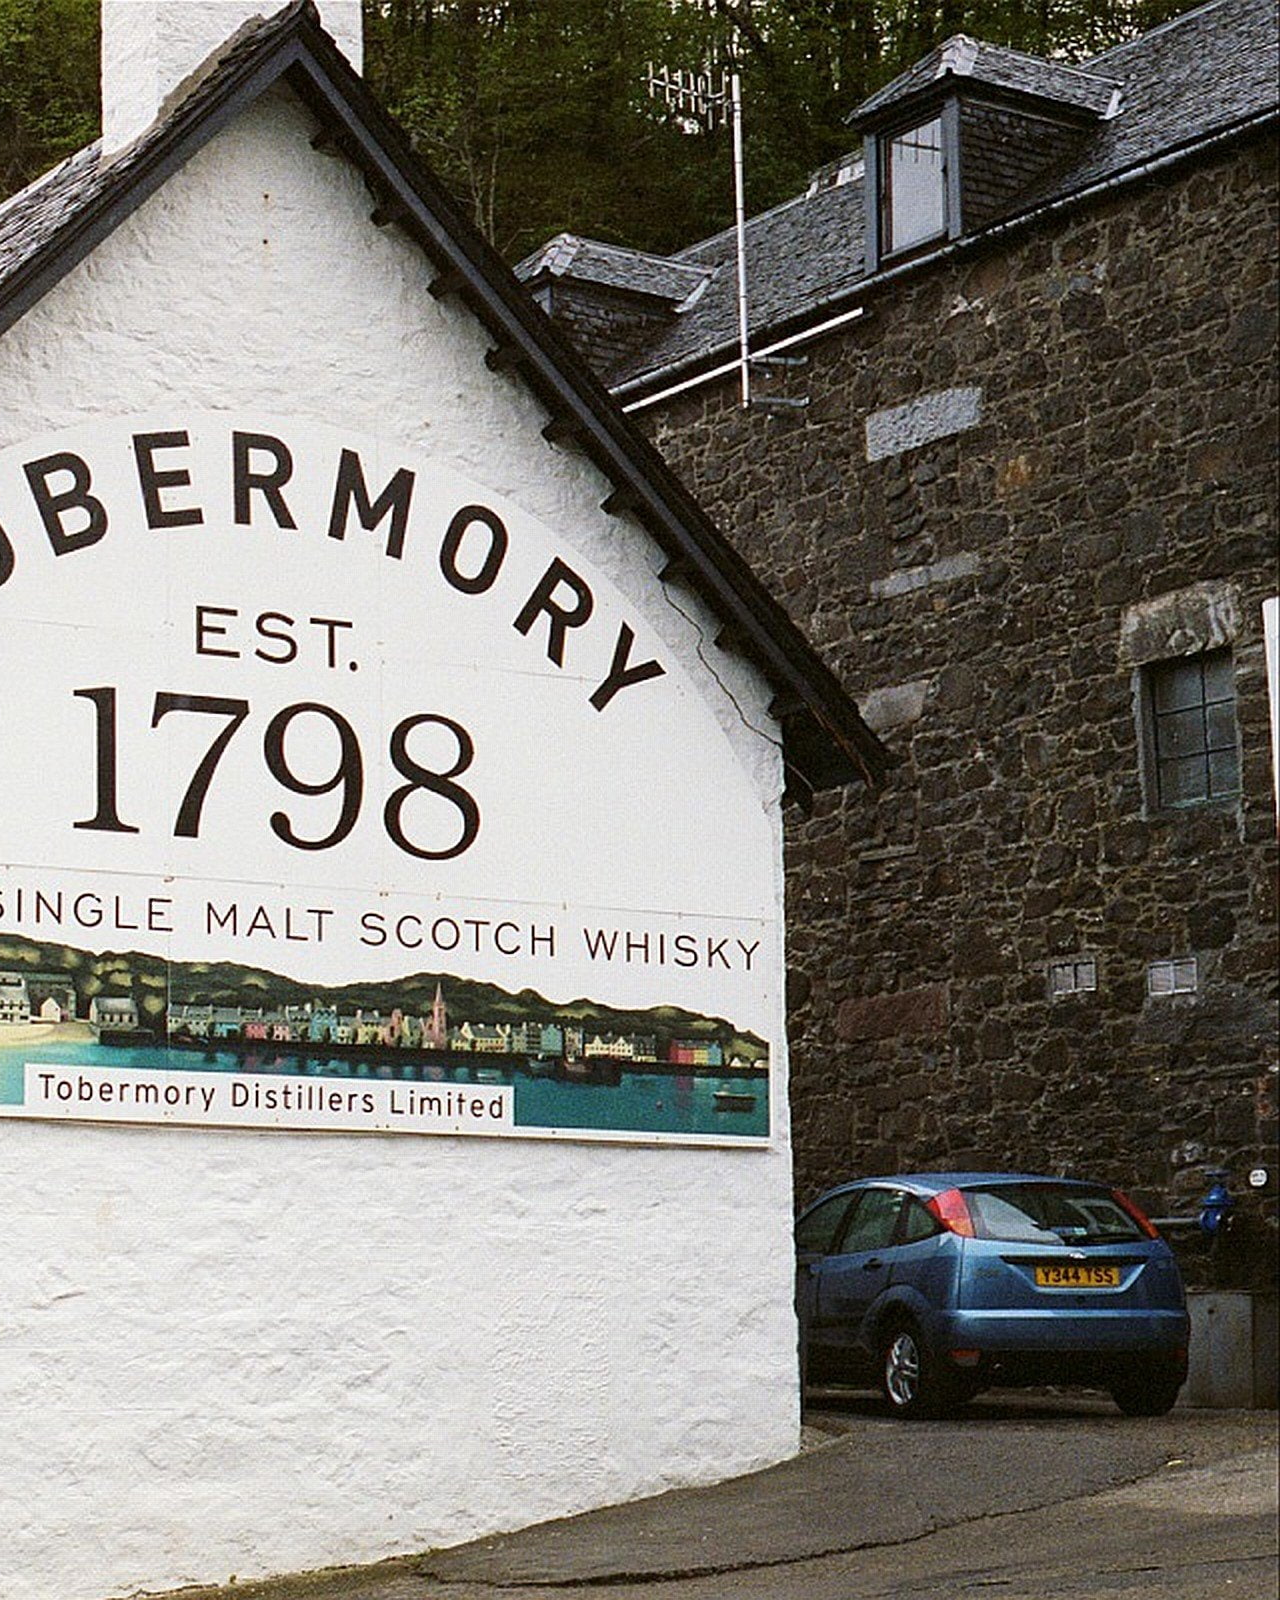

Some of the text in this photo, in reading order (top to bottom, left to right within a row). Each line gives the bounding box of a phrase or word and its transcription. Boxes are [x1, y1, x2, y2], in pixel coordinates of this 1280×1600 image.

[195, 605, 359, 672] EST.
[73, 686, 481, 861] 1798
[206, 901, 334, 942] MALT
[359, 912, 555, 957] SCOTCH
[583, 928, 761, 971] WHISKY
[38, 1073, 504, 1119] Tobermory Distillers Limited
[1042, 1268, 1114, 1284] Y344 YSS
